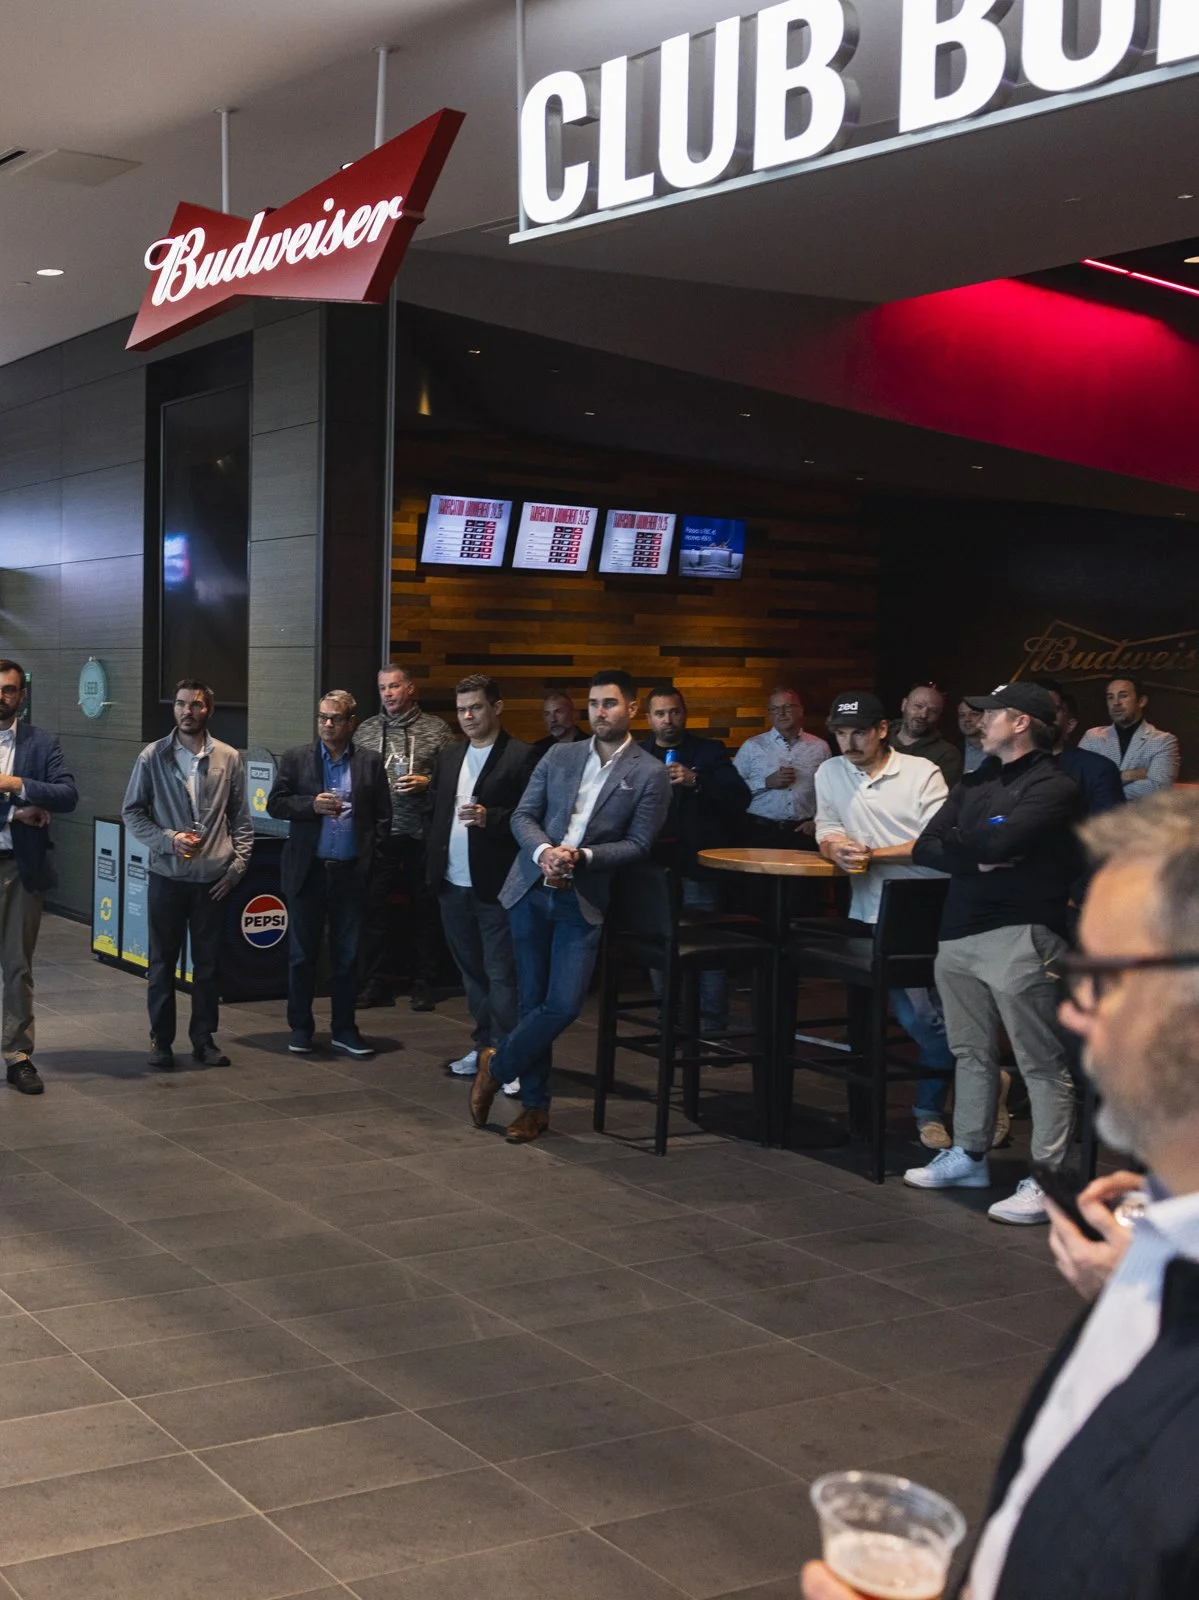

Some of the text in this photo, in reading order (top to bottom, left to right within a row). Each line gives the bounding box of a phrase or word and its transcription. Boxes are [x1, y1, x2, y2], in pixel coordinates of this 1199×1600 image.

[519, 0, 1199, 224] CLUB BU
[144, 195, 403, 306] Budweiser
[837, 701, 859, 712] zed
[244, 914, 286, 928] PEPSI
